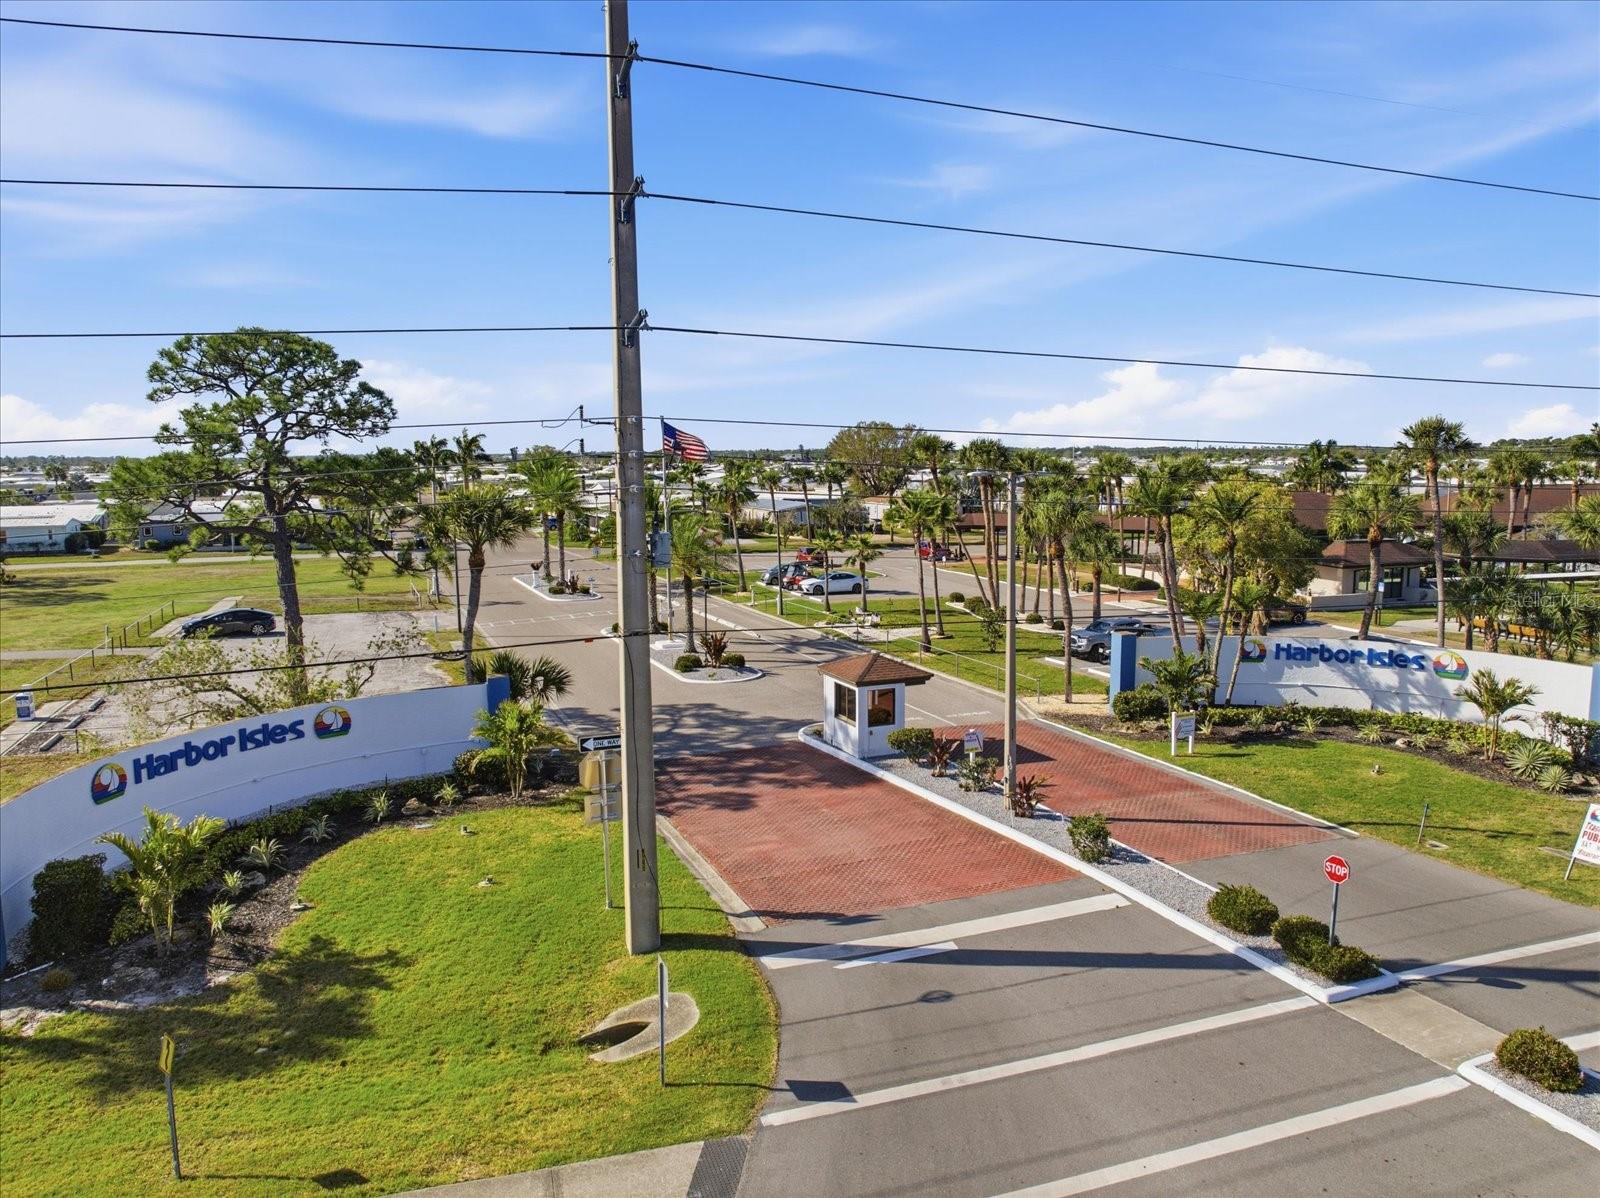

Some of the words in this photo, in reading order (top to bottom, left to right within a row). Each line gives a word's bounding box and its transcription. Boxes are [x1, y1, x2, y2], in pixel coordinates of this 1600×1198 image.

[1274, 643, 1365, 664] Harbor
[1366, 647, 1426, 670] Isles
[133, 735, 236, 784] Harbor
[238, 719, 305, 752] Isles
[607, 738, 620, 746] WAY
[1325, 861, 1348, 877] STOP
